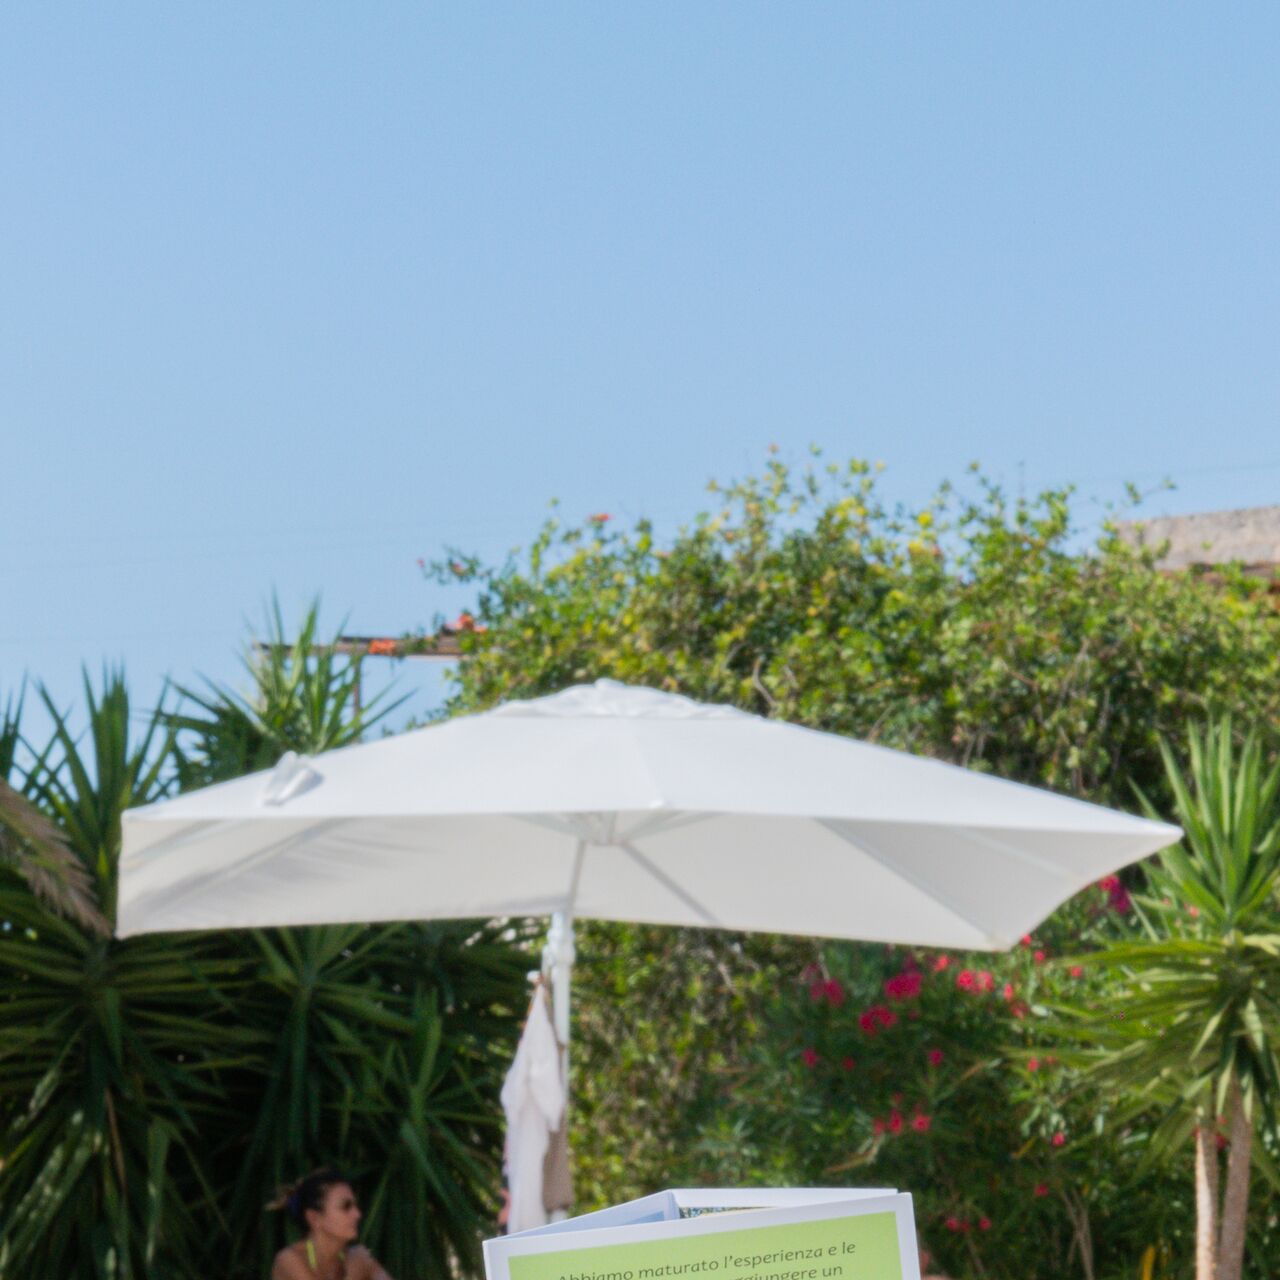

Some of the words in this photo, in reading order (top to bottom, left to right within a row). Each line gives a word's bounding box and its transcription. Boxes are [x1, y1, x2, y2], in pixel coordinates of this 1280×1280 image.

[638, 1259, 719, 1280] maturato
[827, 1245, 838, 1255] e
[841, 1241, 857, 1255] le
[822, 1265, 844, 1278] un
